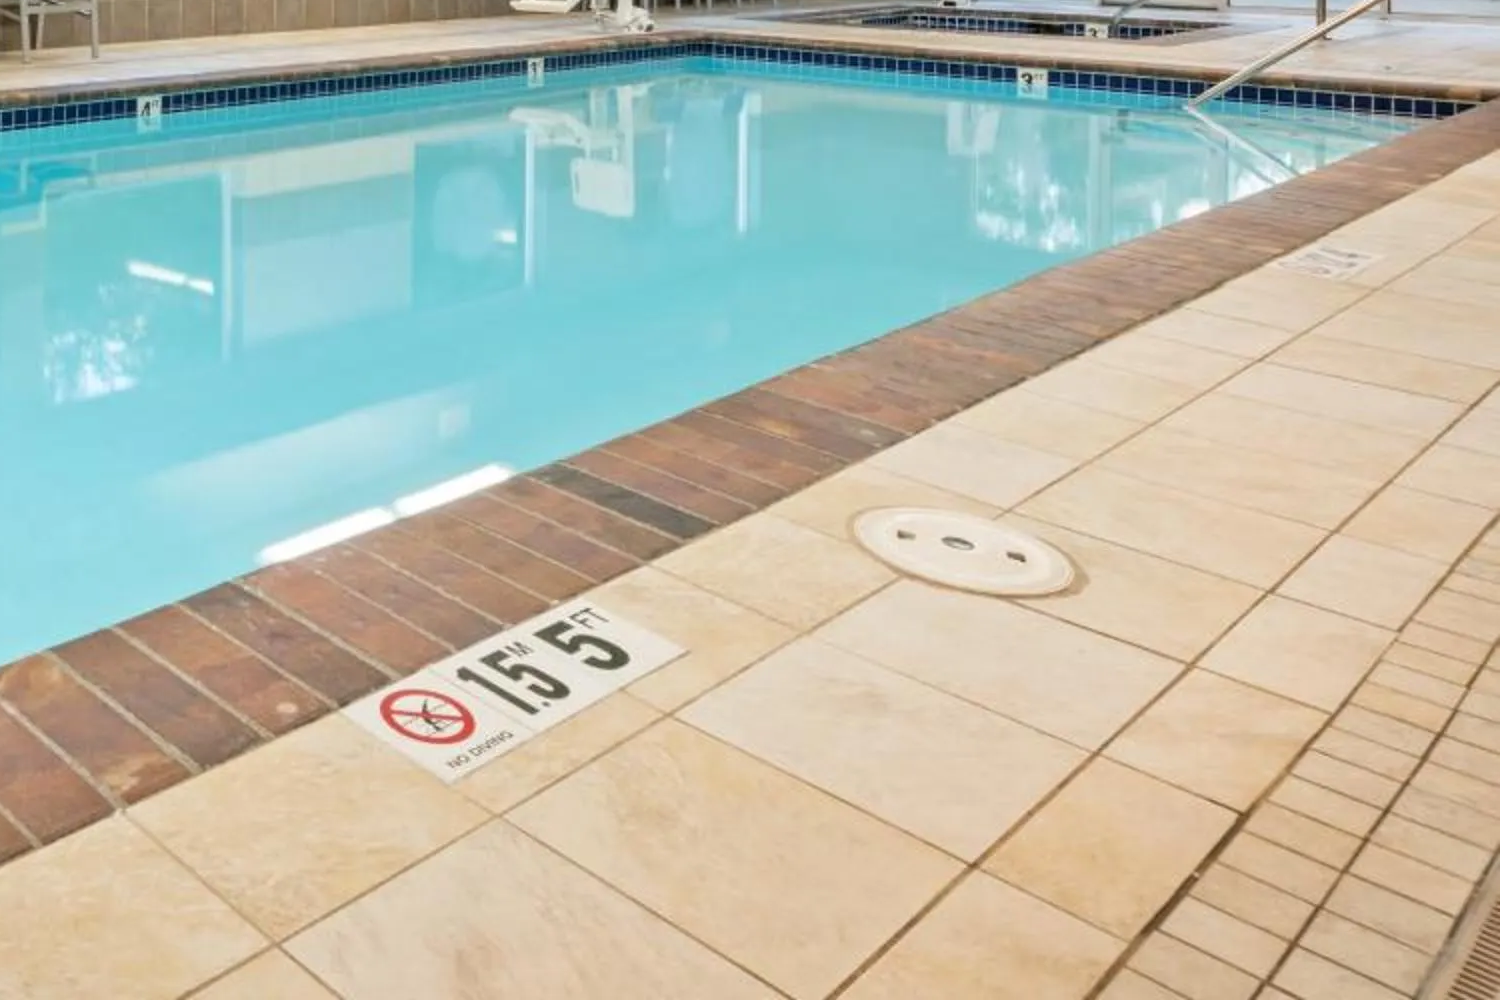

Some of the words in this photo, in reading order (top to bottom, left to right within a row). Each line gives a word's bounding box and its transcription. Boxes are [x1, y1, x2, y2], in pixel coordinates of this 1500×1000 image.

[569, 607, 610, 630] FT
[533, 620, 631, 671] 5
[445, 752, 470, 769] NO
[468, 729, 514, 758] DIVING
